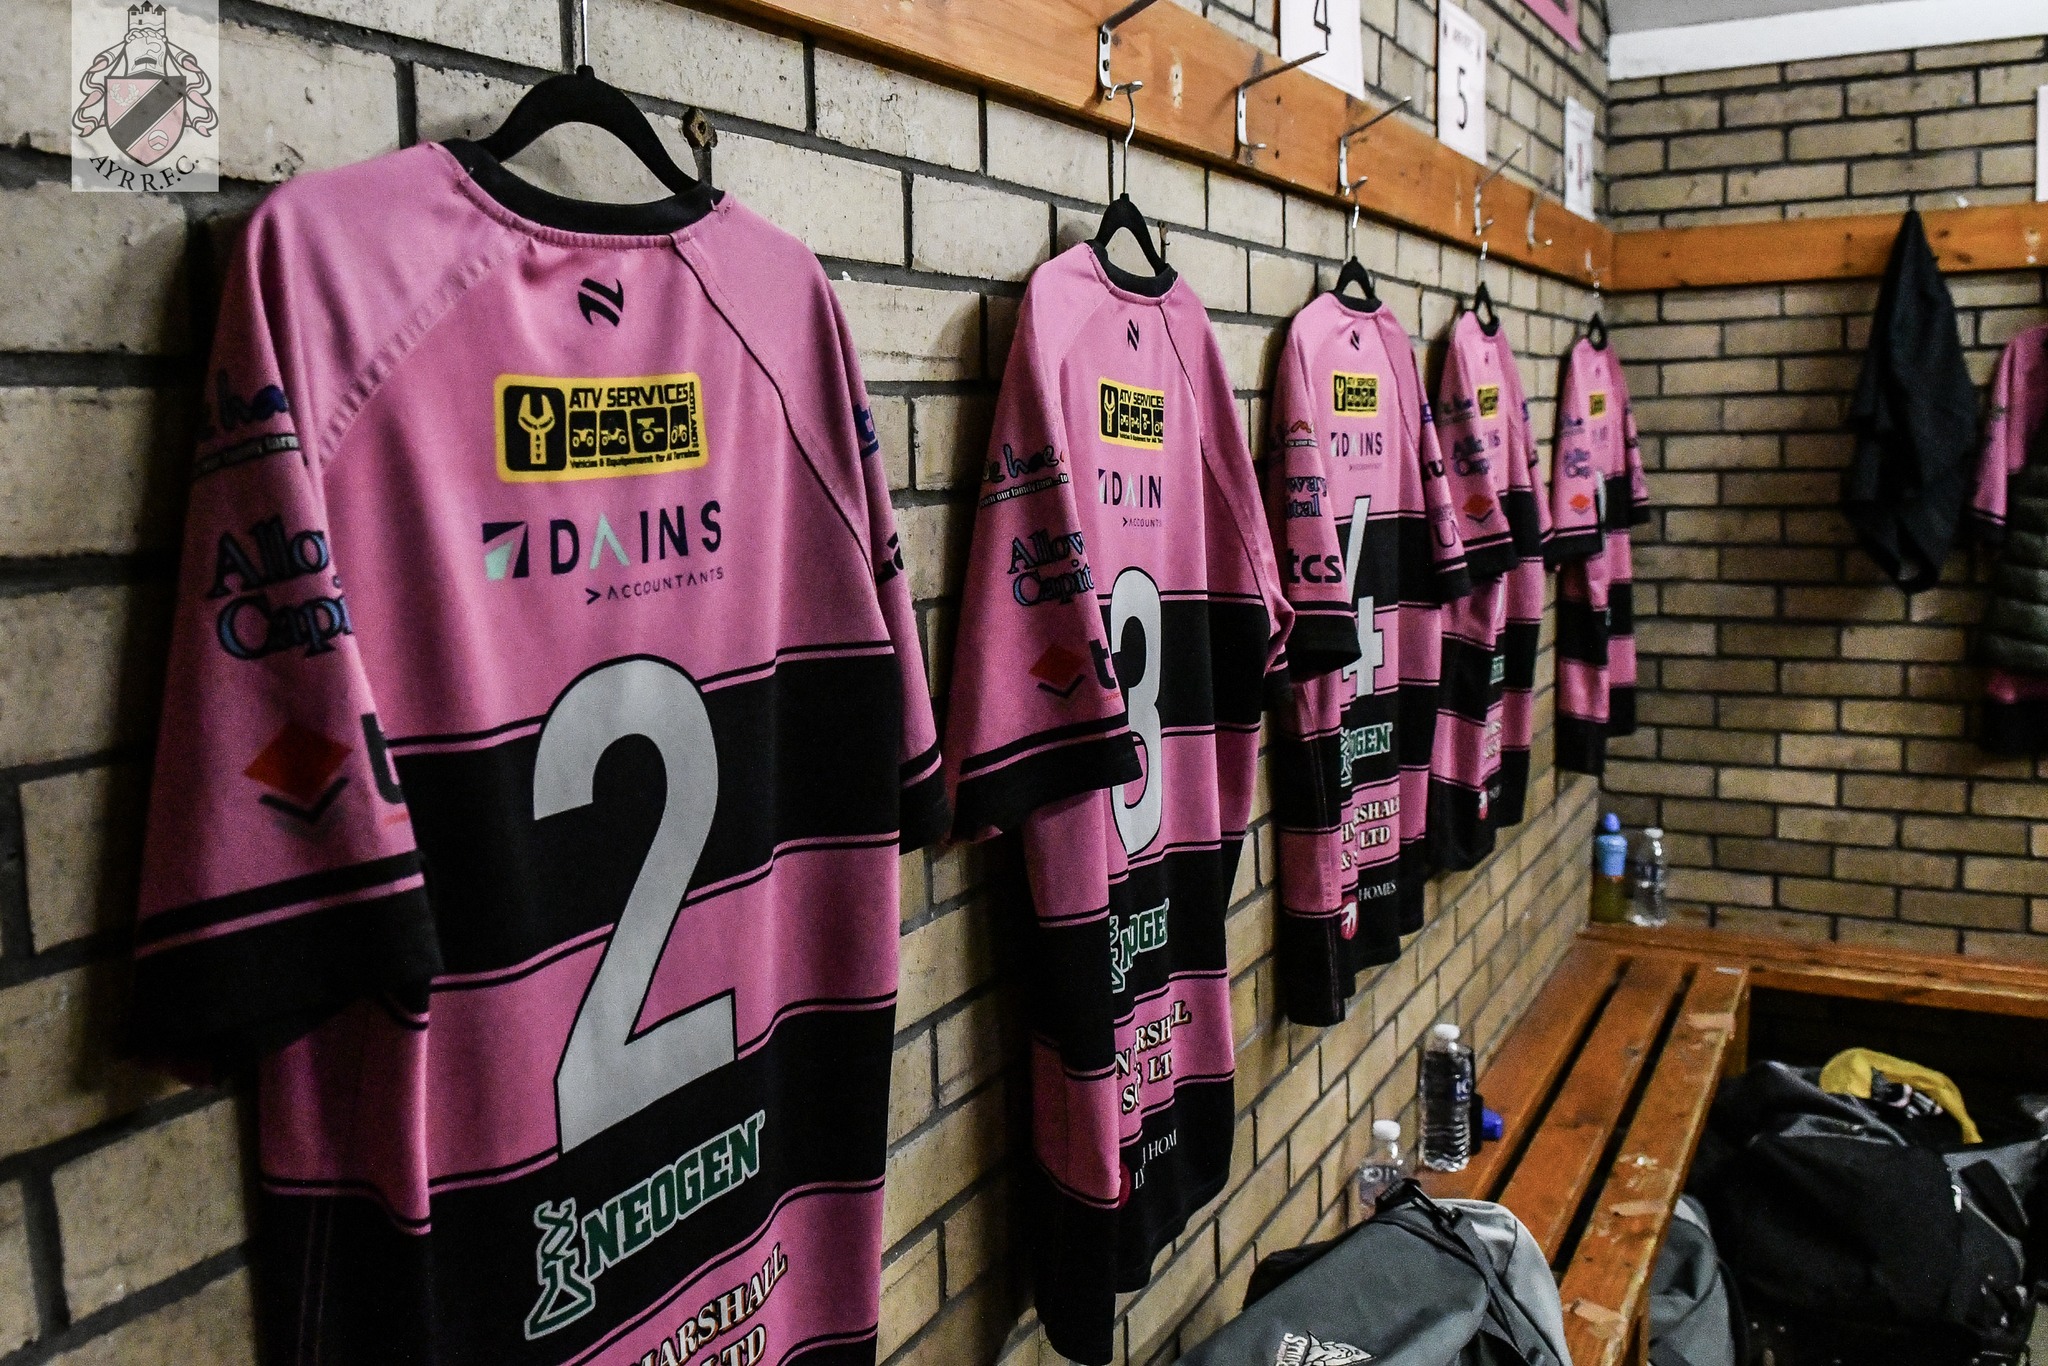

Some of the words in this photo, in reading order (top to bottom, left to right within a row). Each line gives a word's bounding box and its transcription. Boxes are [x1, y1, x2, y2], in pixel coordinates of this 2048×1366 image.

[1456, 66, 1469, 130] 5
[569, 387, 603, 409] ATV
[606, 382, 689, 408] SERVICES
[1119, 389, 1132, 404] ATV
[550, 500, 722, 576] DAINS
[606, 566, 725, 601] ACCOUNTANTS
[1342, 495, 1385, 697] 4
[1110, 566, 1162, 857] 3
[1359, 824, 1392, 850] LTD
[533, 654, 738, 1154] 2
[582, 1110, 764, 1282] NEOGEN
